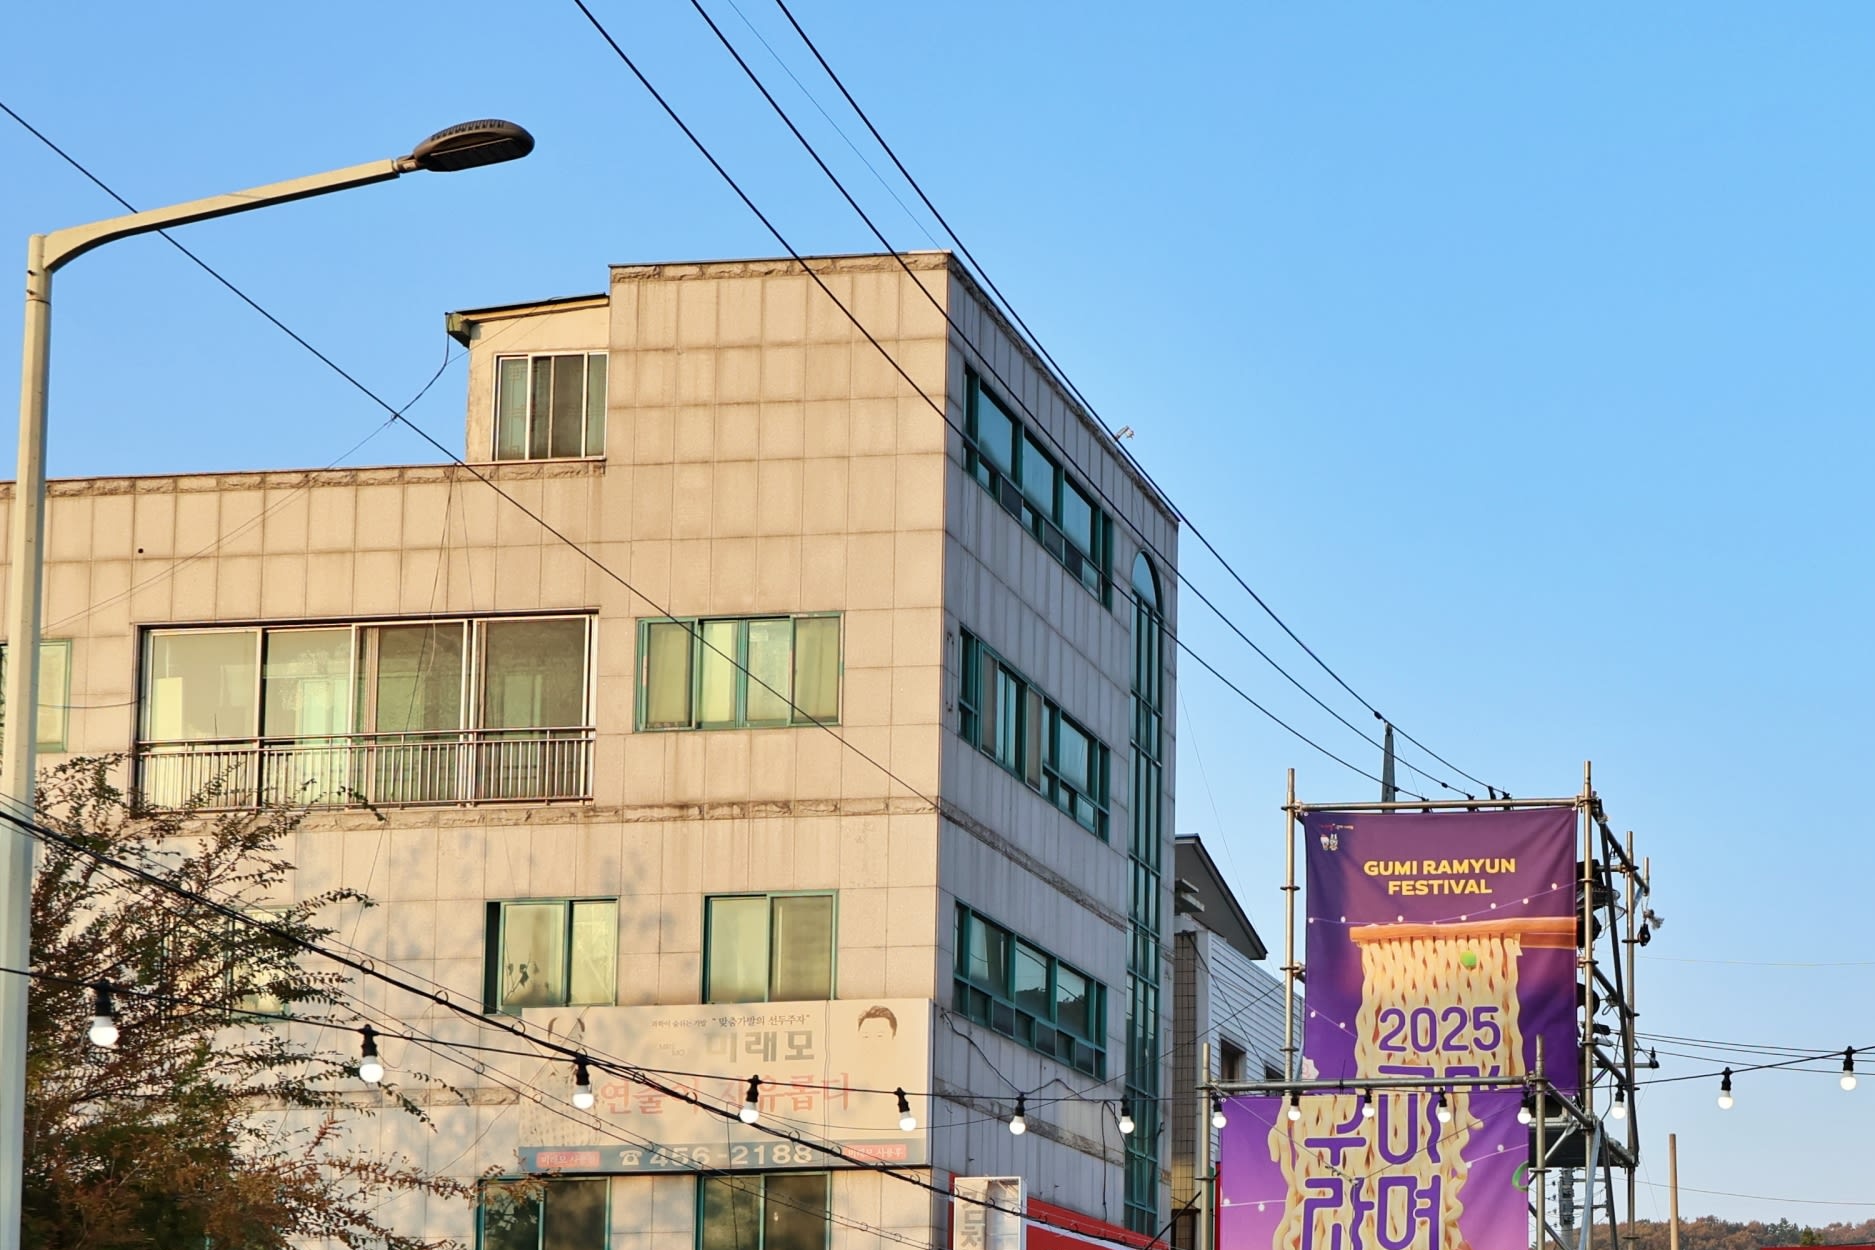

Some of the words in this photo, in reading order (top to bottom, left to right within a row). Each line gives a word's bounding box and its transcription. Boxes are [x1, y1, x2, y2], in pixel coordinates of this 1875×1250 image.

[1362, 859, 1418, 877] GUMI
[1422, 857, 1517, 876] RAMYUN
[1387, 878, 1493, 896] FESTIVAL
[1378, 1005, 1501, 1053] 2025
[704, 1029, 816, 1063] 미래모
[649, 1145, 814, 1168] 456-2188
